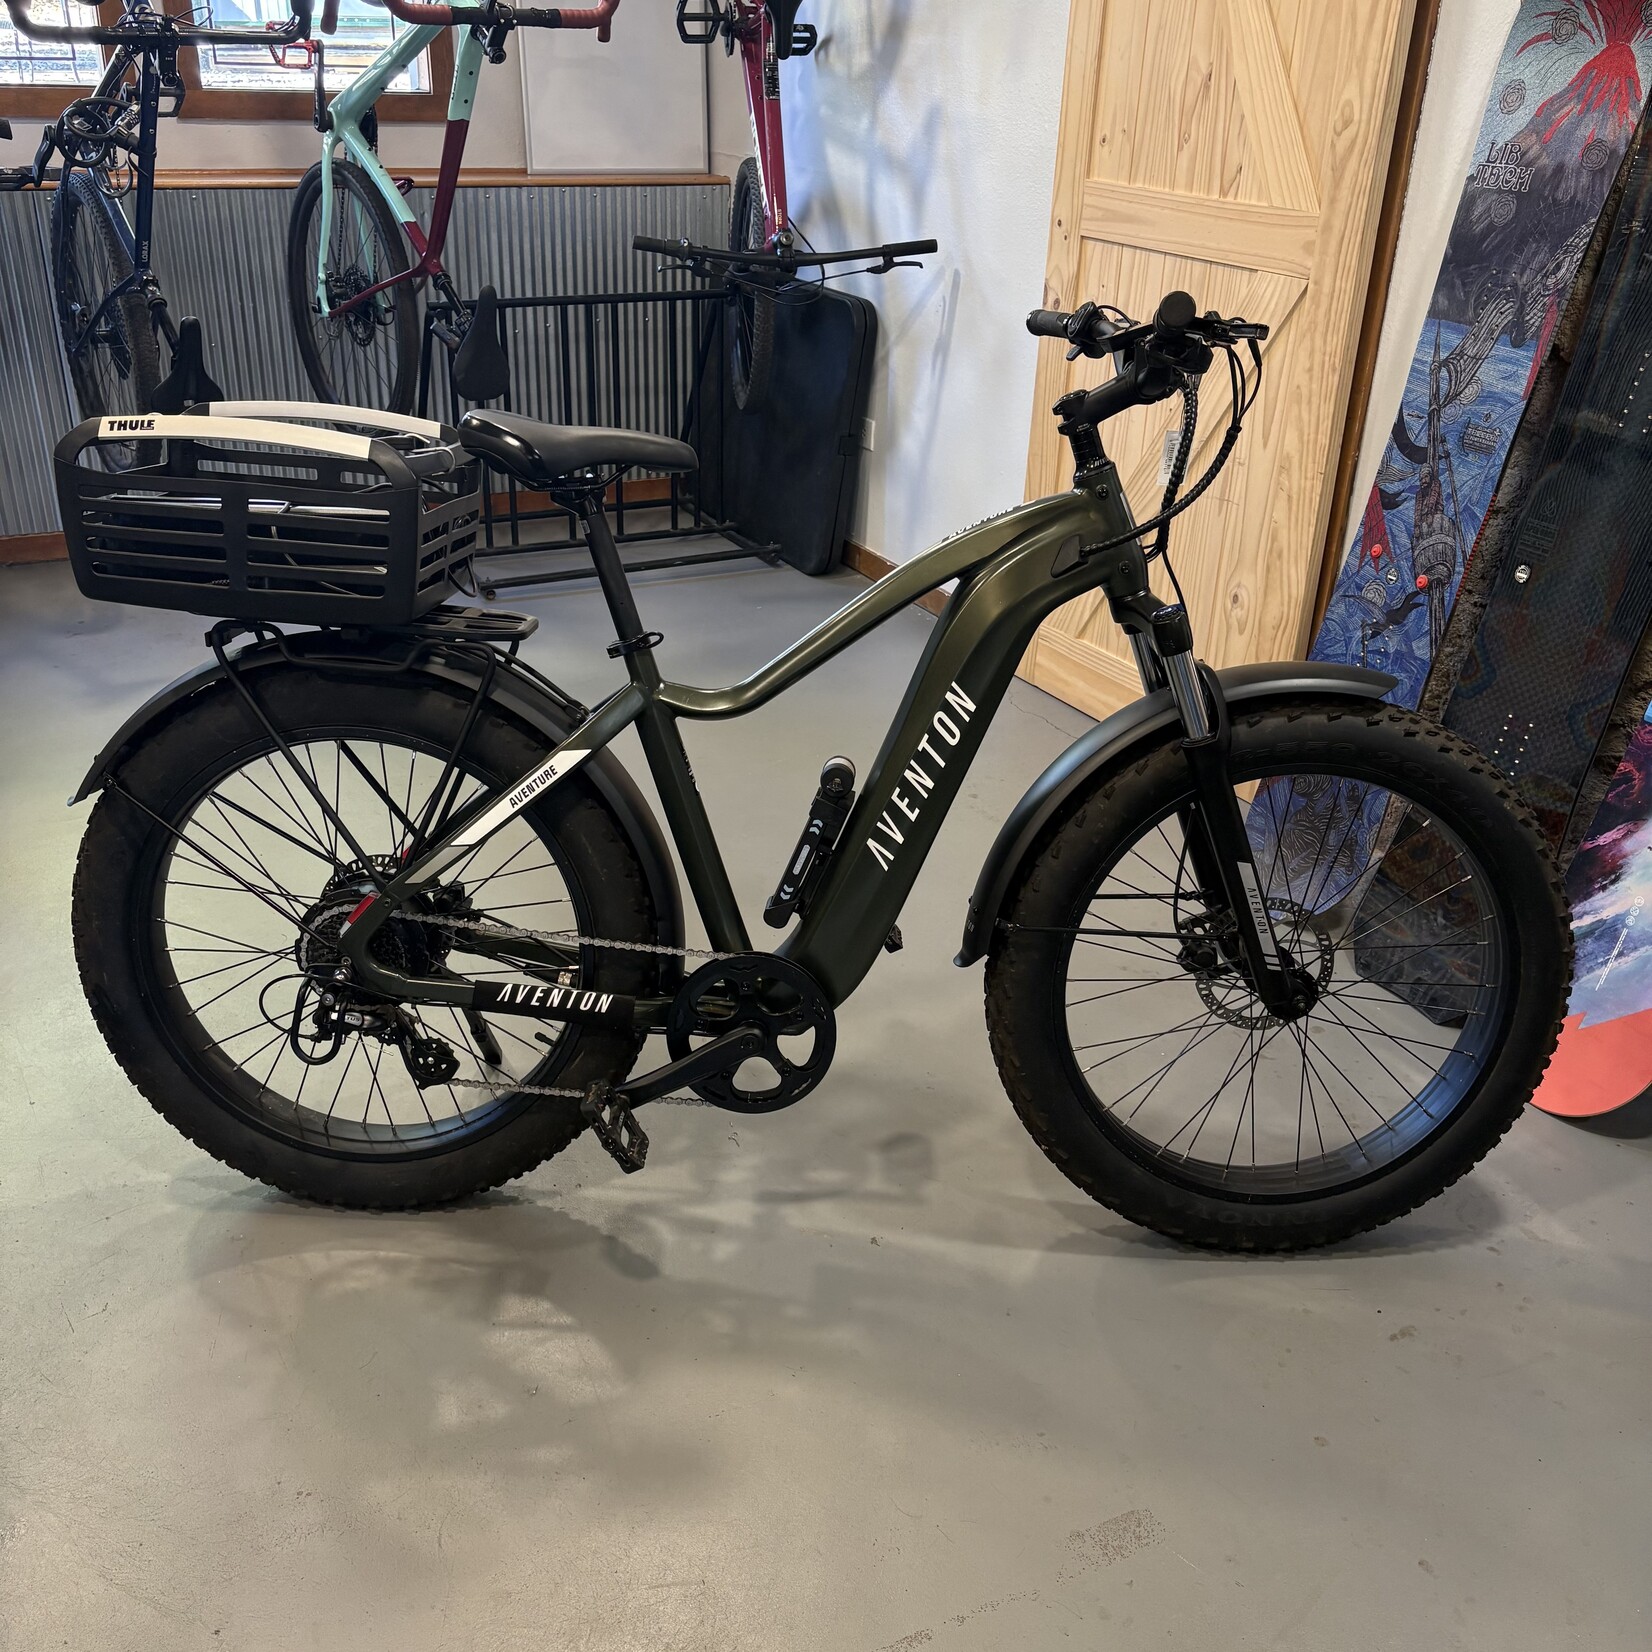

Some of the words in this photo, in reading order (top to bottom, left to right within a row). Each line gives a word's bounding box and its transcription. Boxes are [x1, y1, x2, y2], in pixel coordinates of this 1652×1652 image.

[1485, 140, 1523, 165] LIB
[1474, 164, 1535, 192] TECH
[141, 240, 149, 262] LORAX
[108, 419, 156, 431] THULE
[508, 764, 558, 809] AVENTURE
[866, 681, 977, 872] AVENTON
[1247, 887, 1269, 934] AVENTON
[496, 983, 614, 1014] AVENTON
